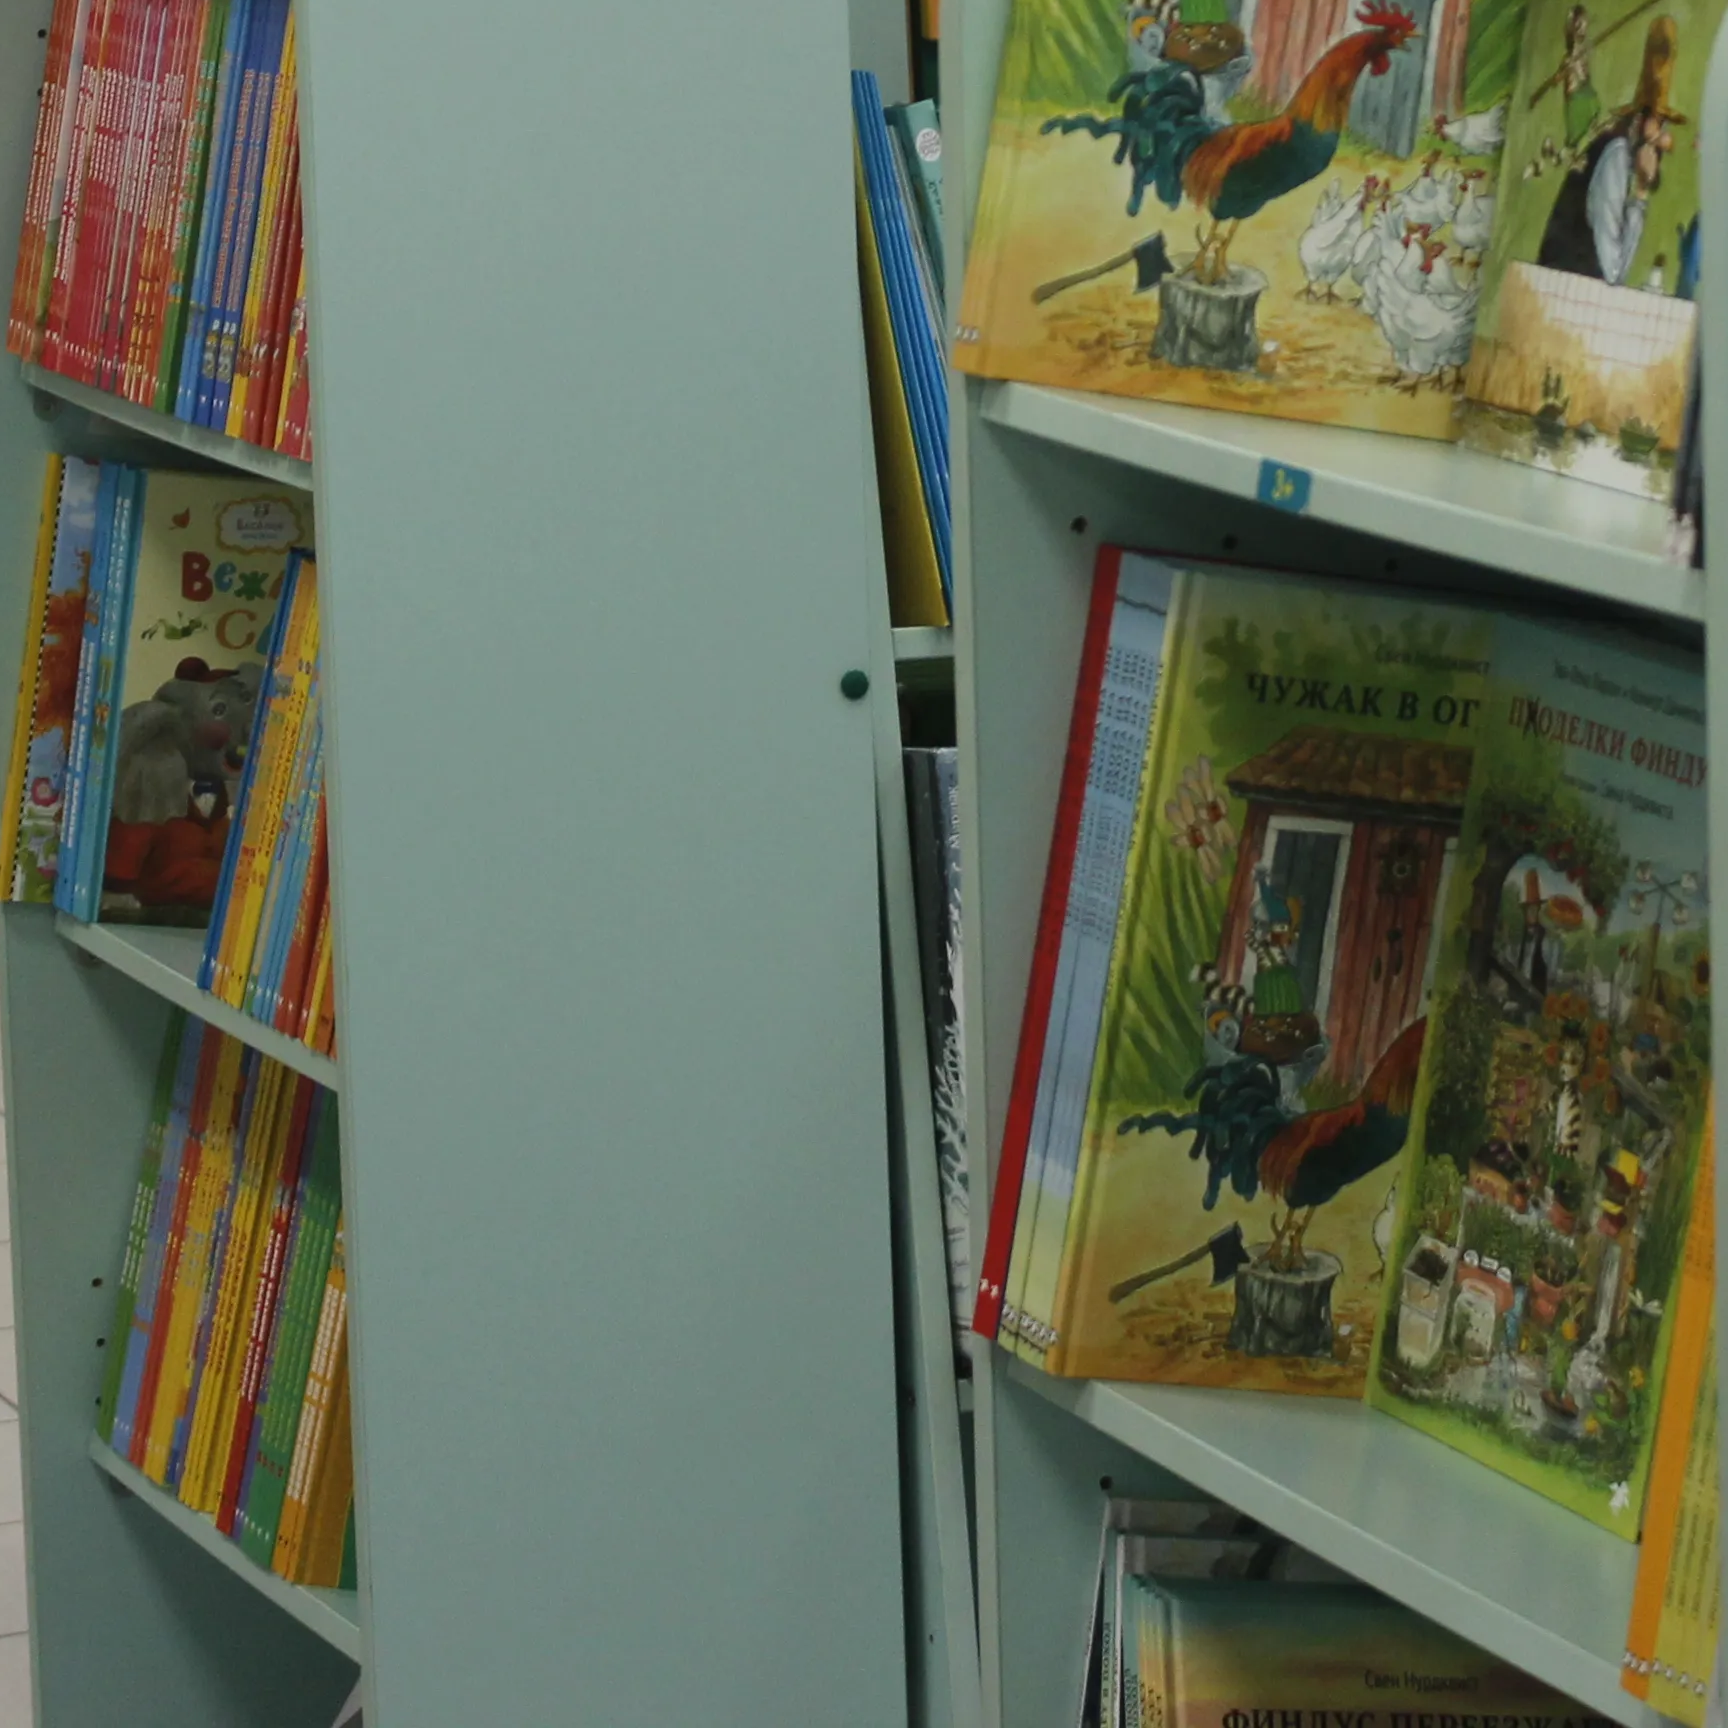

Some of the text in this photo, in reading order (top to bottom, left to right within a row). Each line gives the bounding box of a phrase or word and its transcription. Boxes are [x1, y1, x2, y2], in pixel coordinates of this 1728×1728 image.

[1245, 670, 1482, 729] ЧУЖАК В ОГ
[1364, 1670, 1400, 1690] Свен
